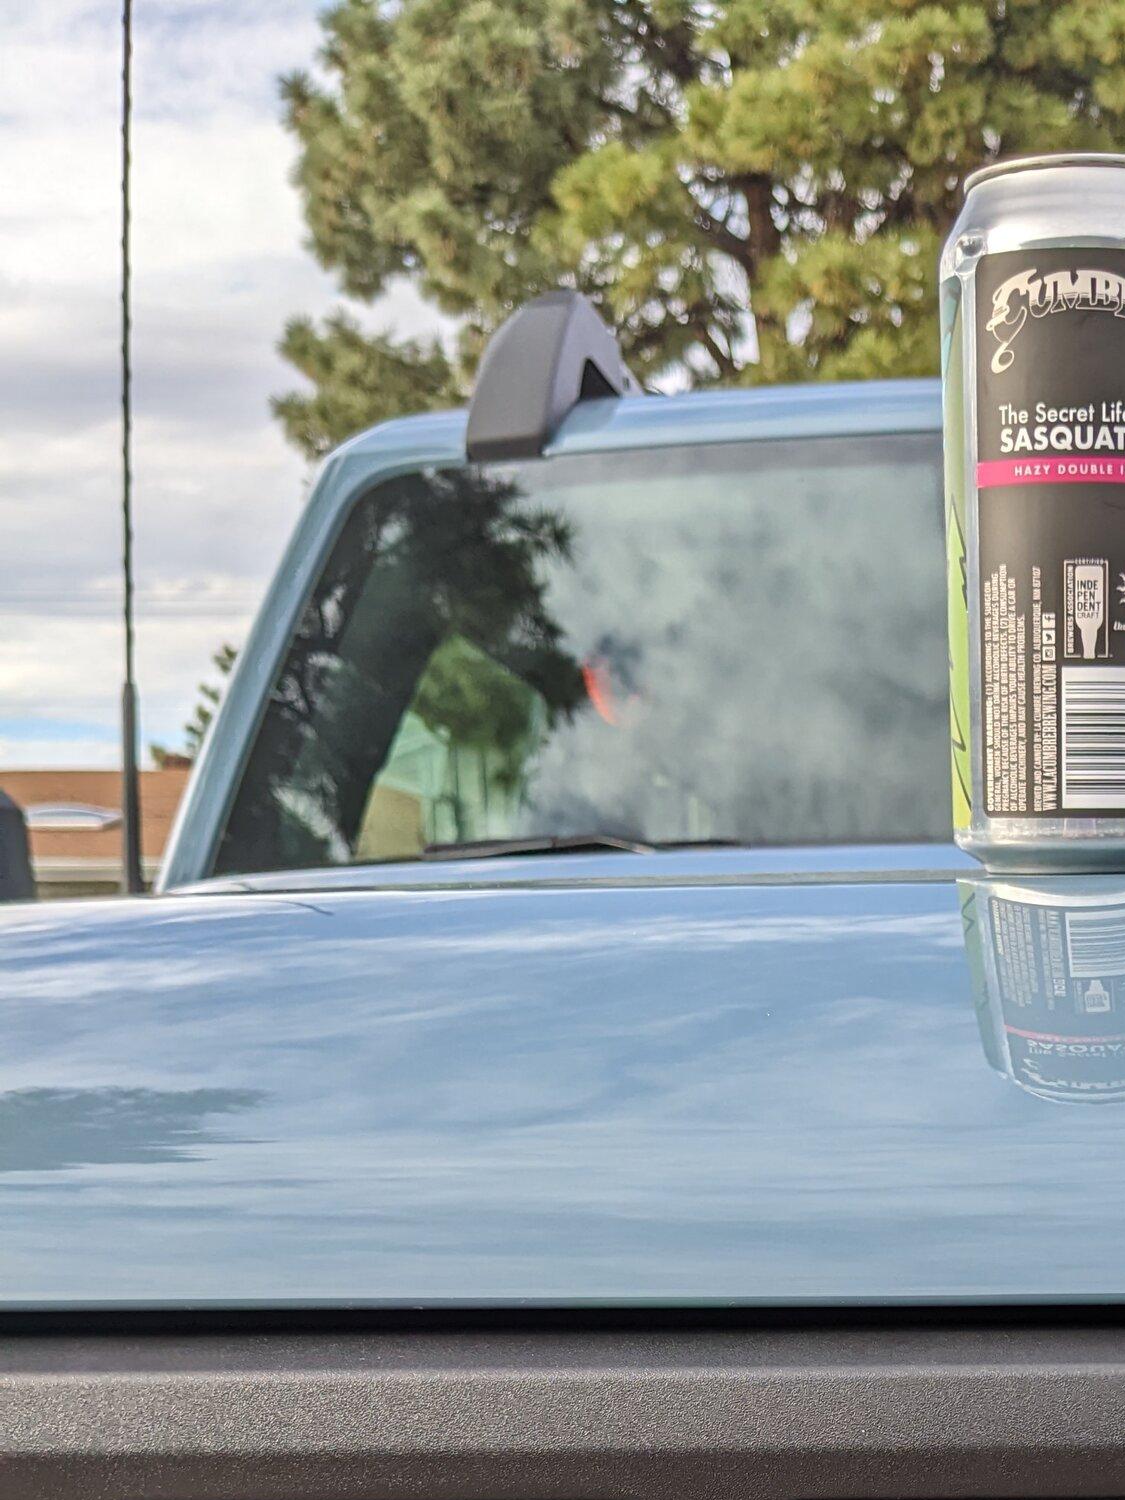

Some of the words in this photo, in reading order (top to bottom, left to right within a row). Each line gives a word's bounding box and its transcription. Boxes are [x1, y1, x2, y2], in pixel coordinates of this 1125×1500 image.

[999, 403, 1028, 425] The
[1035, 402, 1094, 423] Secret
[1014, 465, 1049, 476] HAZY
[1058, 464, 1113, 475] DOUBLE
[1032, 566, 1040, 588] 87107
[1008, 578, 1015, 588] OR
[1077, 580, 1098, 590] INDE
[1033, 589, 1041, 600] NM
[1077, 591, 1096, 601] PEN
[1077, 602, 1101, 612] DENT
[1000, 618, 1008, 629] (2)
[1033, 602, 1042, 650] ALBUQUERQUE,
[984, 632, 992, 641] TO
[1008, 635, 1016, 644] TO
[1033, 652, 1041, 663] CO.
[1033, 664, 1041, 693] BREWING
[985, 684, 993, 695] (1)
[1000, 686, 1008, 695] OF
[1001, 729, 1008, 738] OF
[1042, 664, 1057, 811] WWW.LACUMBREBREWING.COM
[1018, 739, 1027, 780] MACHINERY,
[1010, 802, 1017, 811] OF
